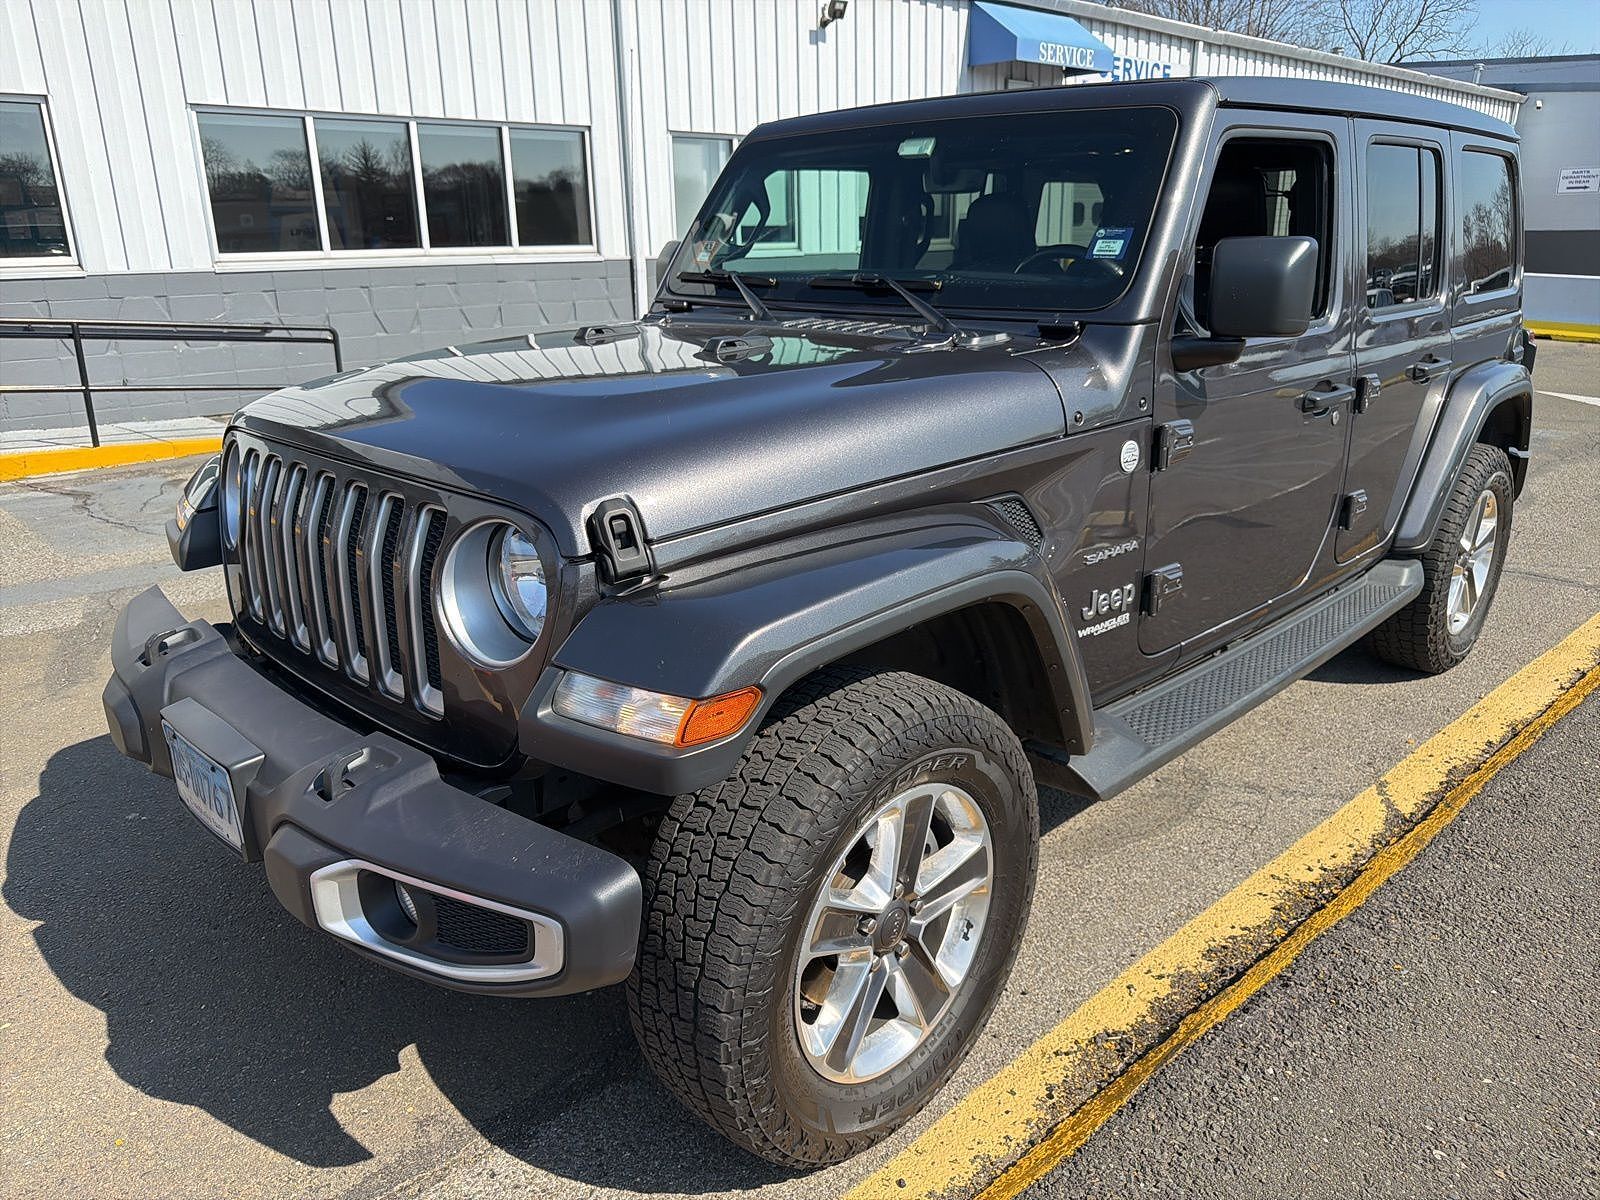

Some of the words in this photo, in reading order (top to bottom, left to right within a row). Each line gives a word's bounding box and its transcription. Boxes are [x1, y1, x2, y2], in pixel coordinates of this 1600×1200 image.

[1039, 41, 1094, 68] SERVICE
[1099, 57, 1172, 82] ERVICE
[1084, 540, 1139, 565] SAHARA
[1081, 583, 1136, 621] Jeep
[1077, 612, 1130, 638] WRANGLER
